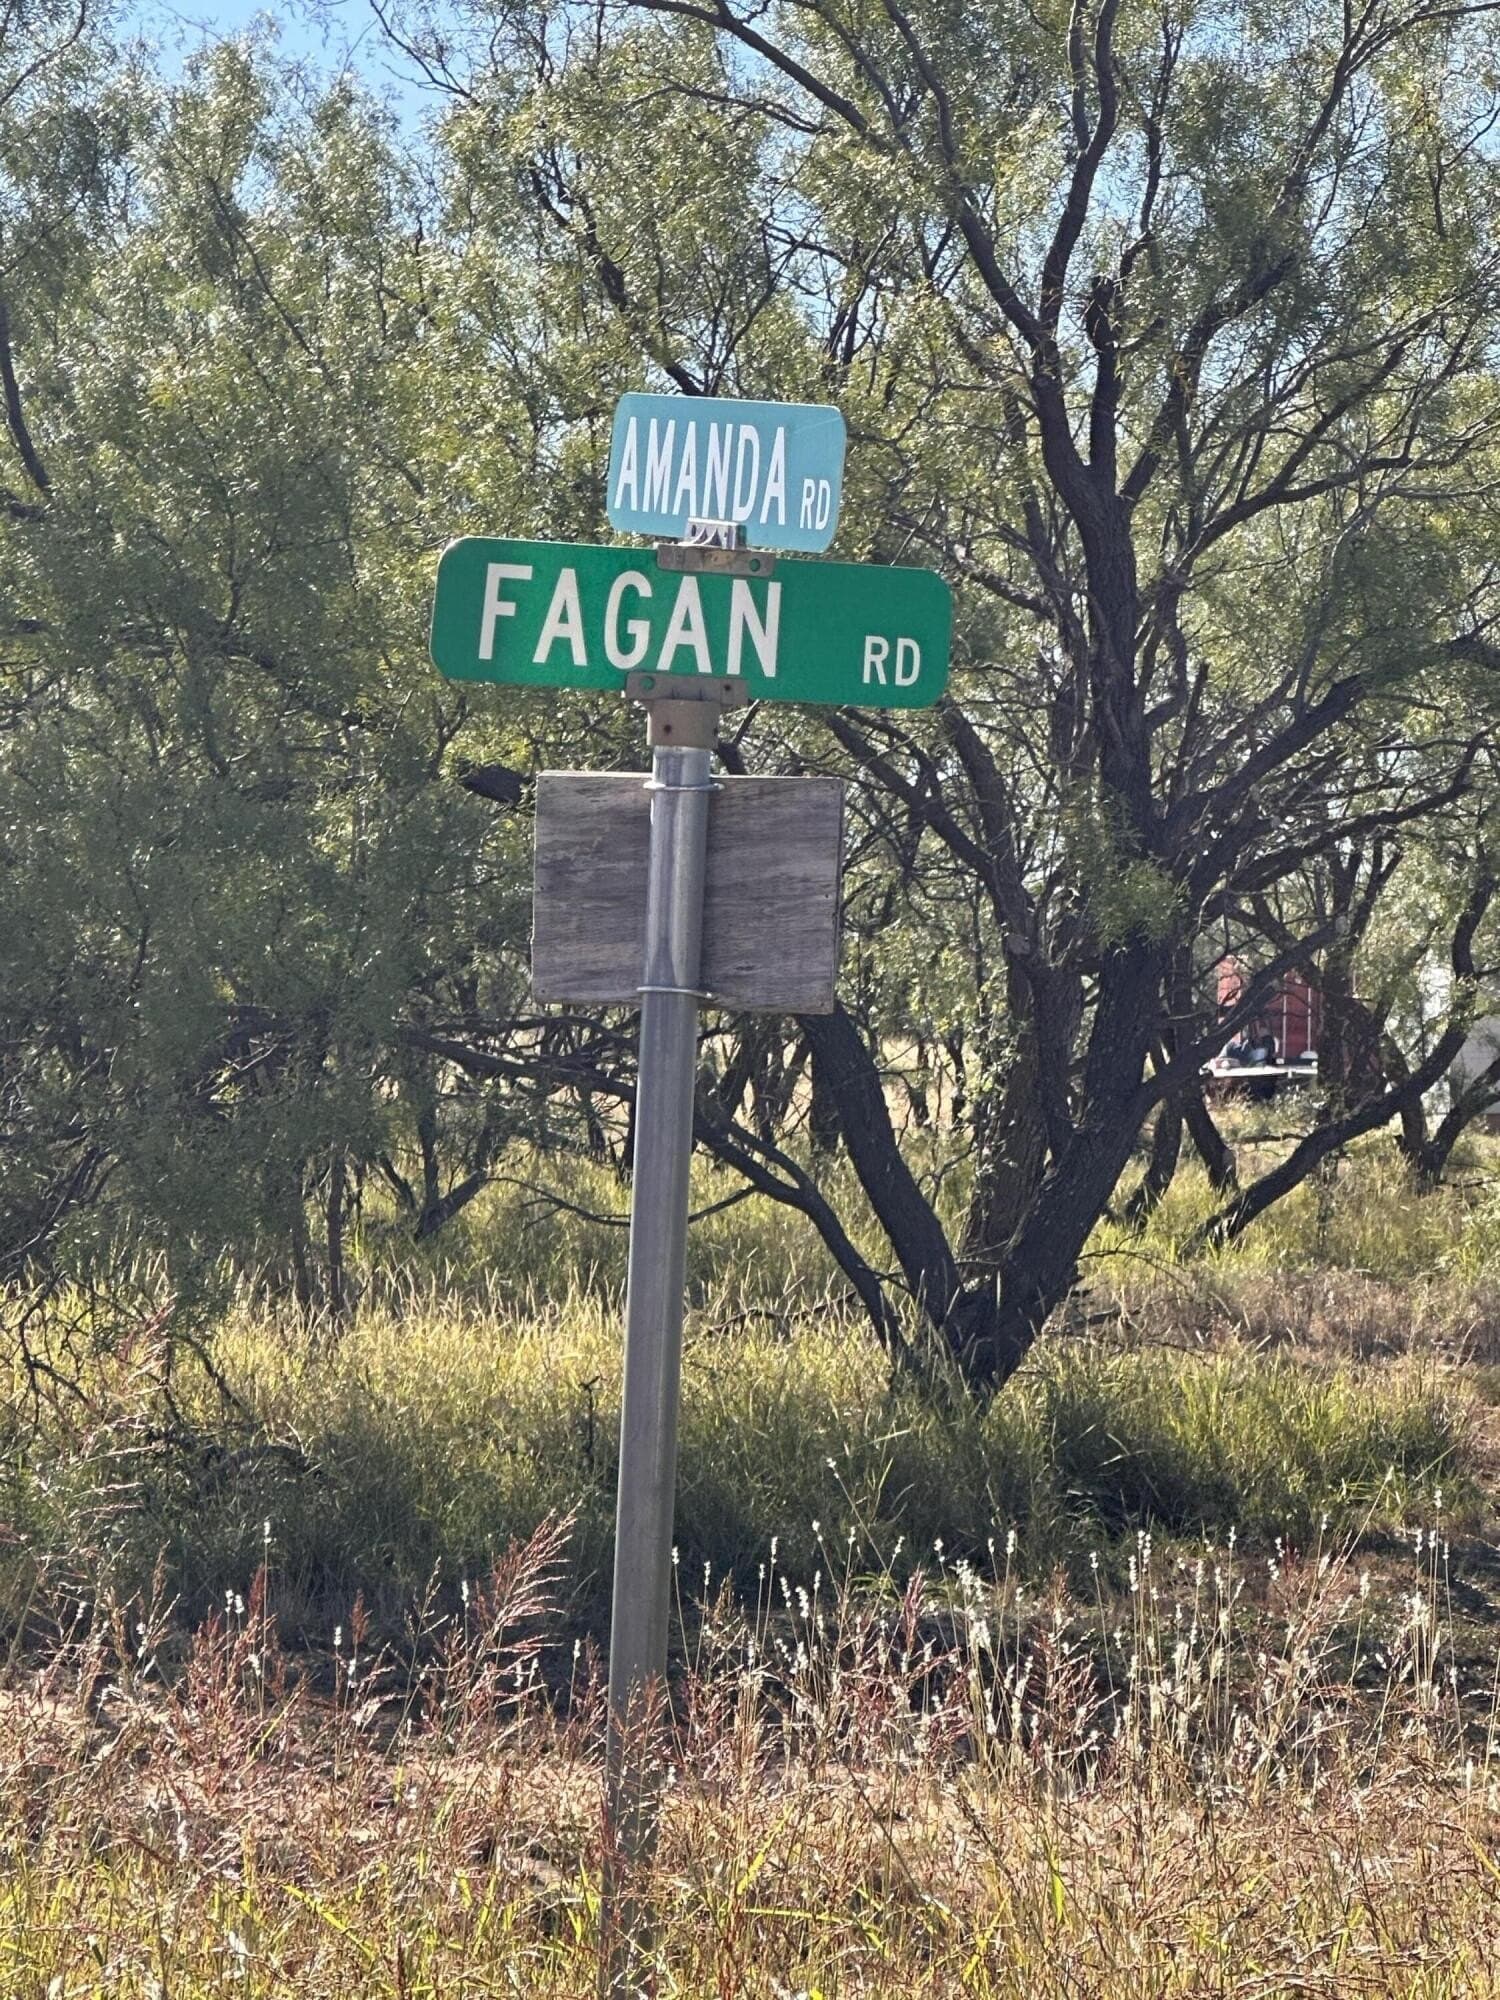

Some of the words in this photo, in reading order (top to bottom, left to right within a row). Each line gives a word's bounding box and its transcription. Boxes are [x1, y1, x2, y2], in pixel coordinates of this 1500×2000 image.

[614, 416, 786, 526] AMANDA
[801, 479, 831, 530] RD
[478, 563, 782, 678] FAGAN
[862, 635, 921, 686] RD
